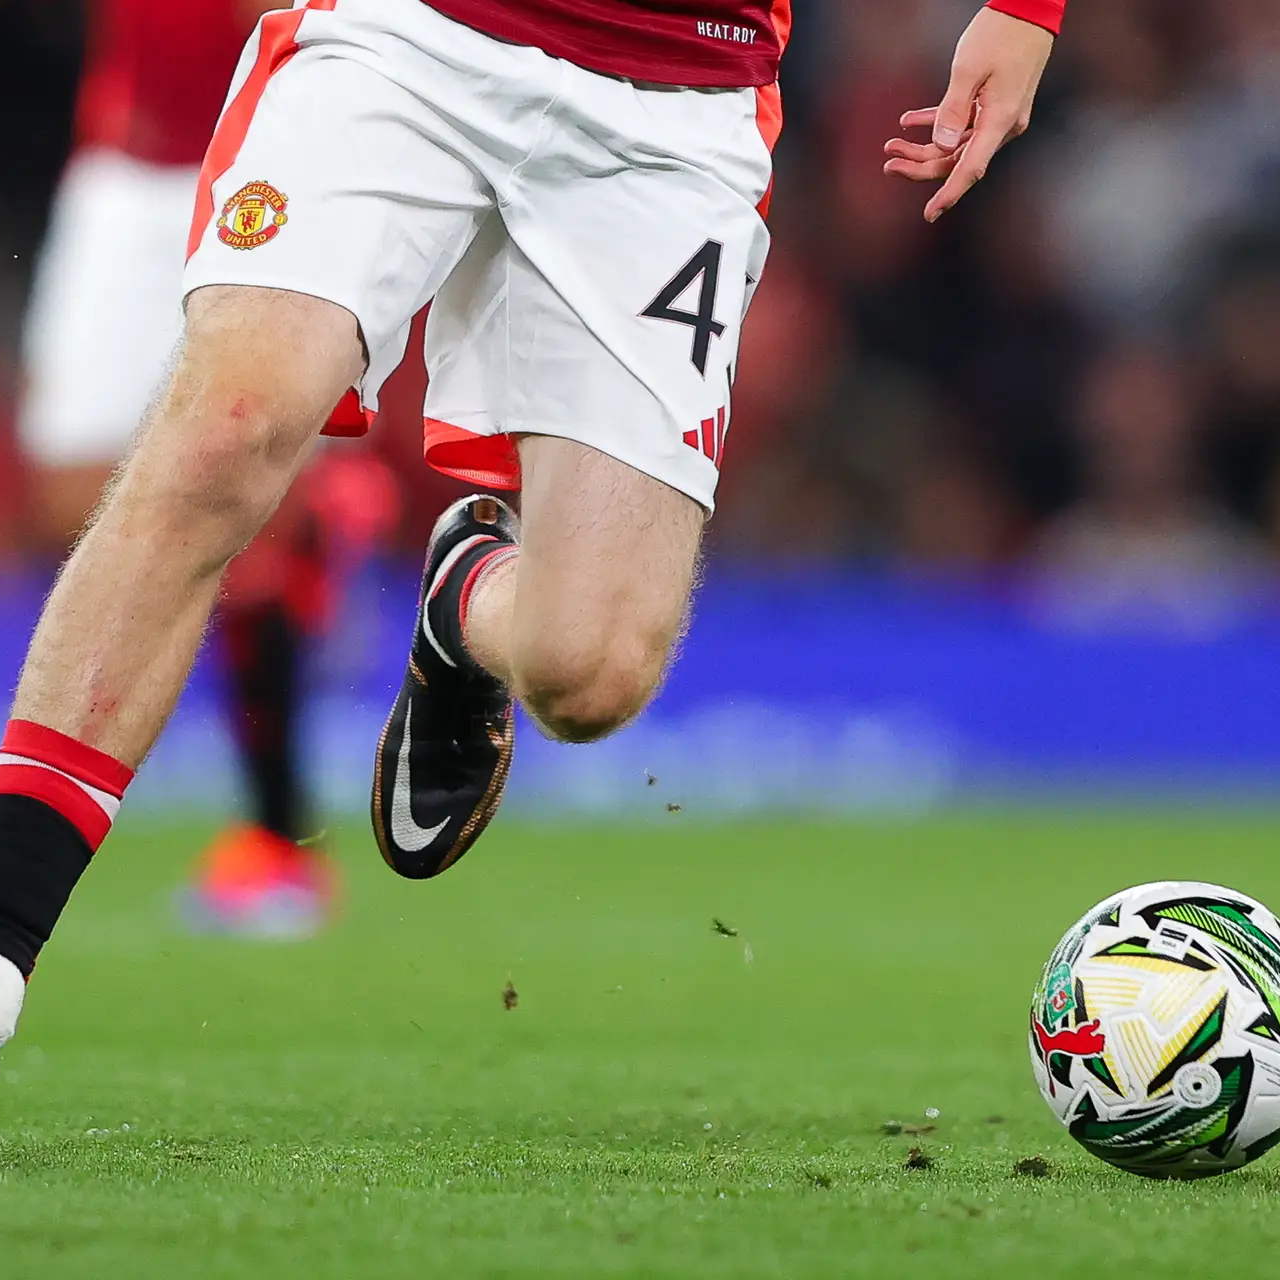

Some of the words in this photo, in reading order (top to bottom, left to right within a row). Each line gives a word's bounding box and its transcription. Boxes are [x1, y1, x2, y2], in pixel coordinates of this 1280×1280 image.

[697, 21, 757, 44] HEAT.RDY
[226, 185, 283, 209] MANCHESTER
[225, 233, 267, 246] UNITED
